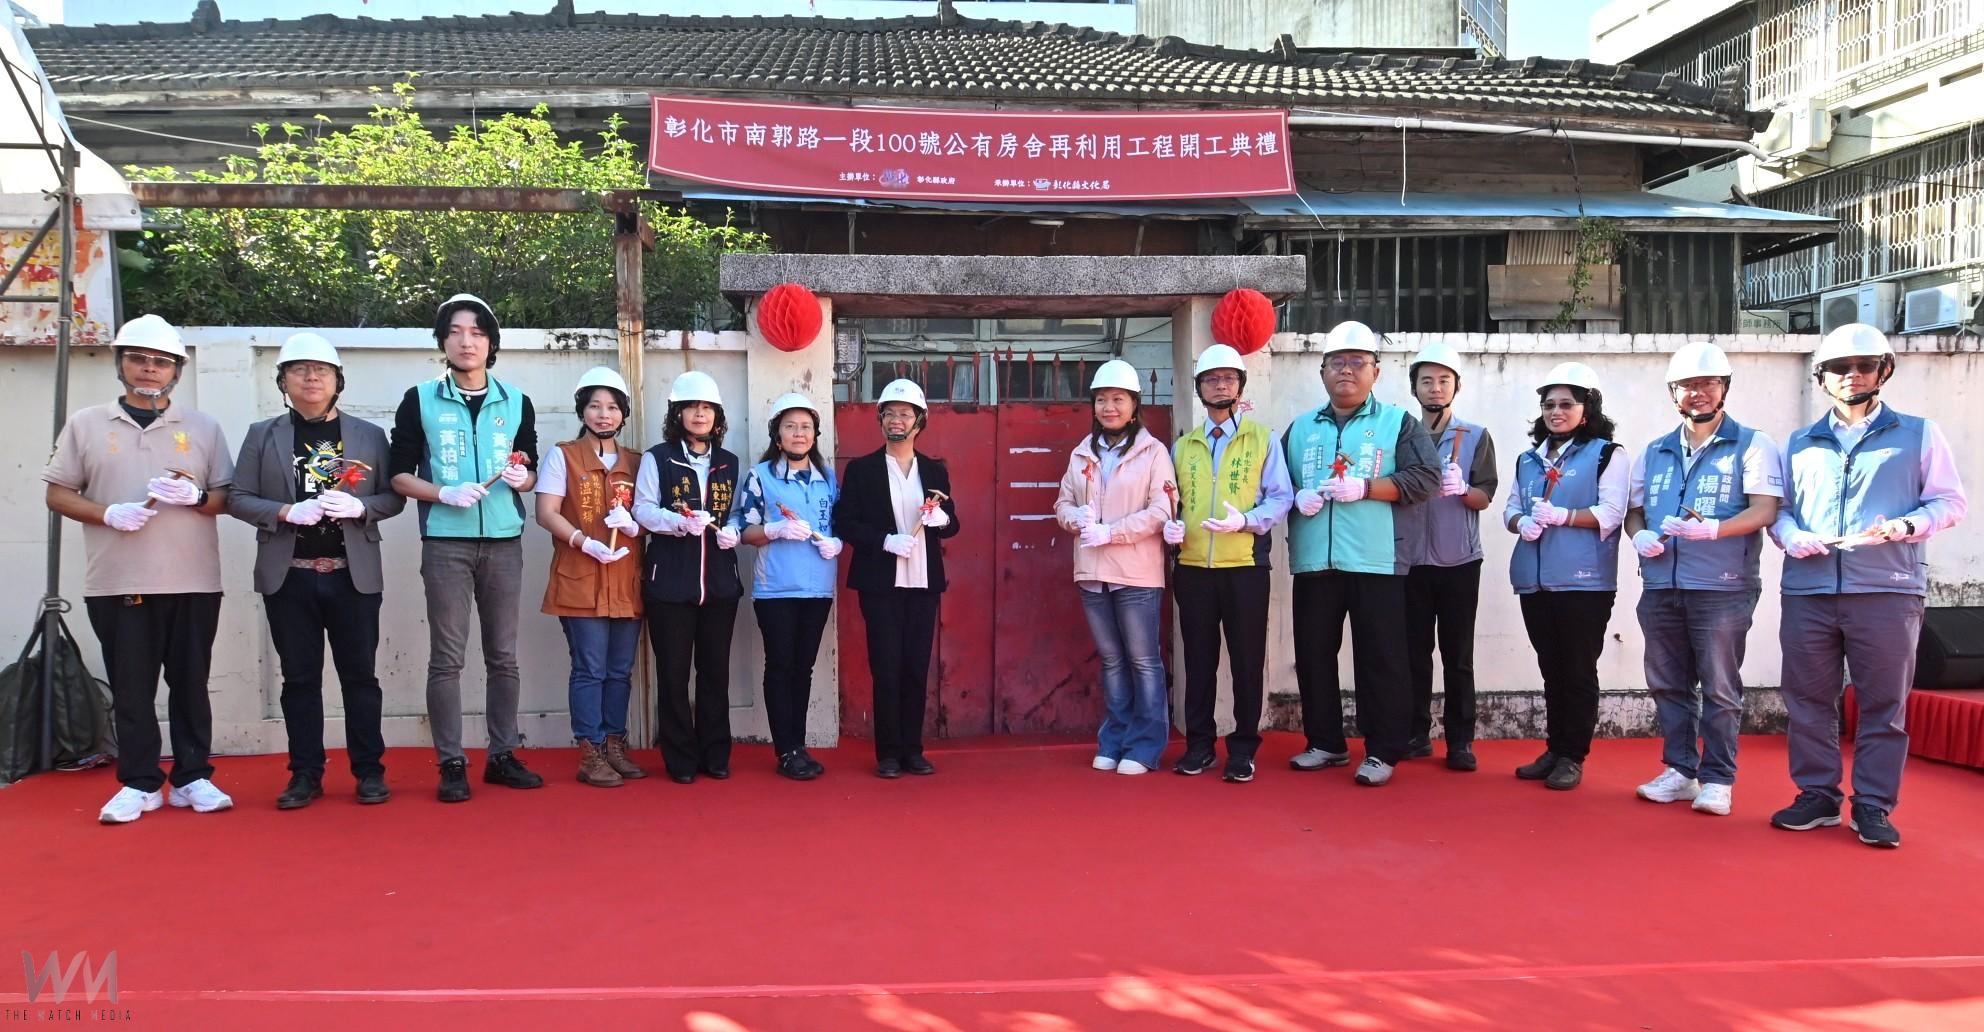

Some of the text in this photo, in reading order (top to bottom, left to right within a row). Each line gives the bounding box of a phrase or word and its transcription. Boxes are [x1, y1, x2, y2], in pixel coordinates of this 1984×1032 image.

[664, 115, 1279, 159] 彰化市南郭路一段100號公有房舍再利用工程開工典禮
[1229, 457, 1242, 495] 林世賢
